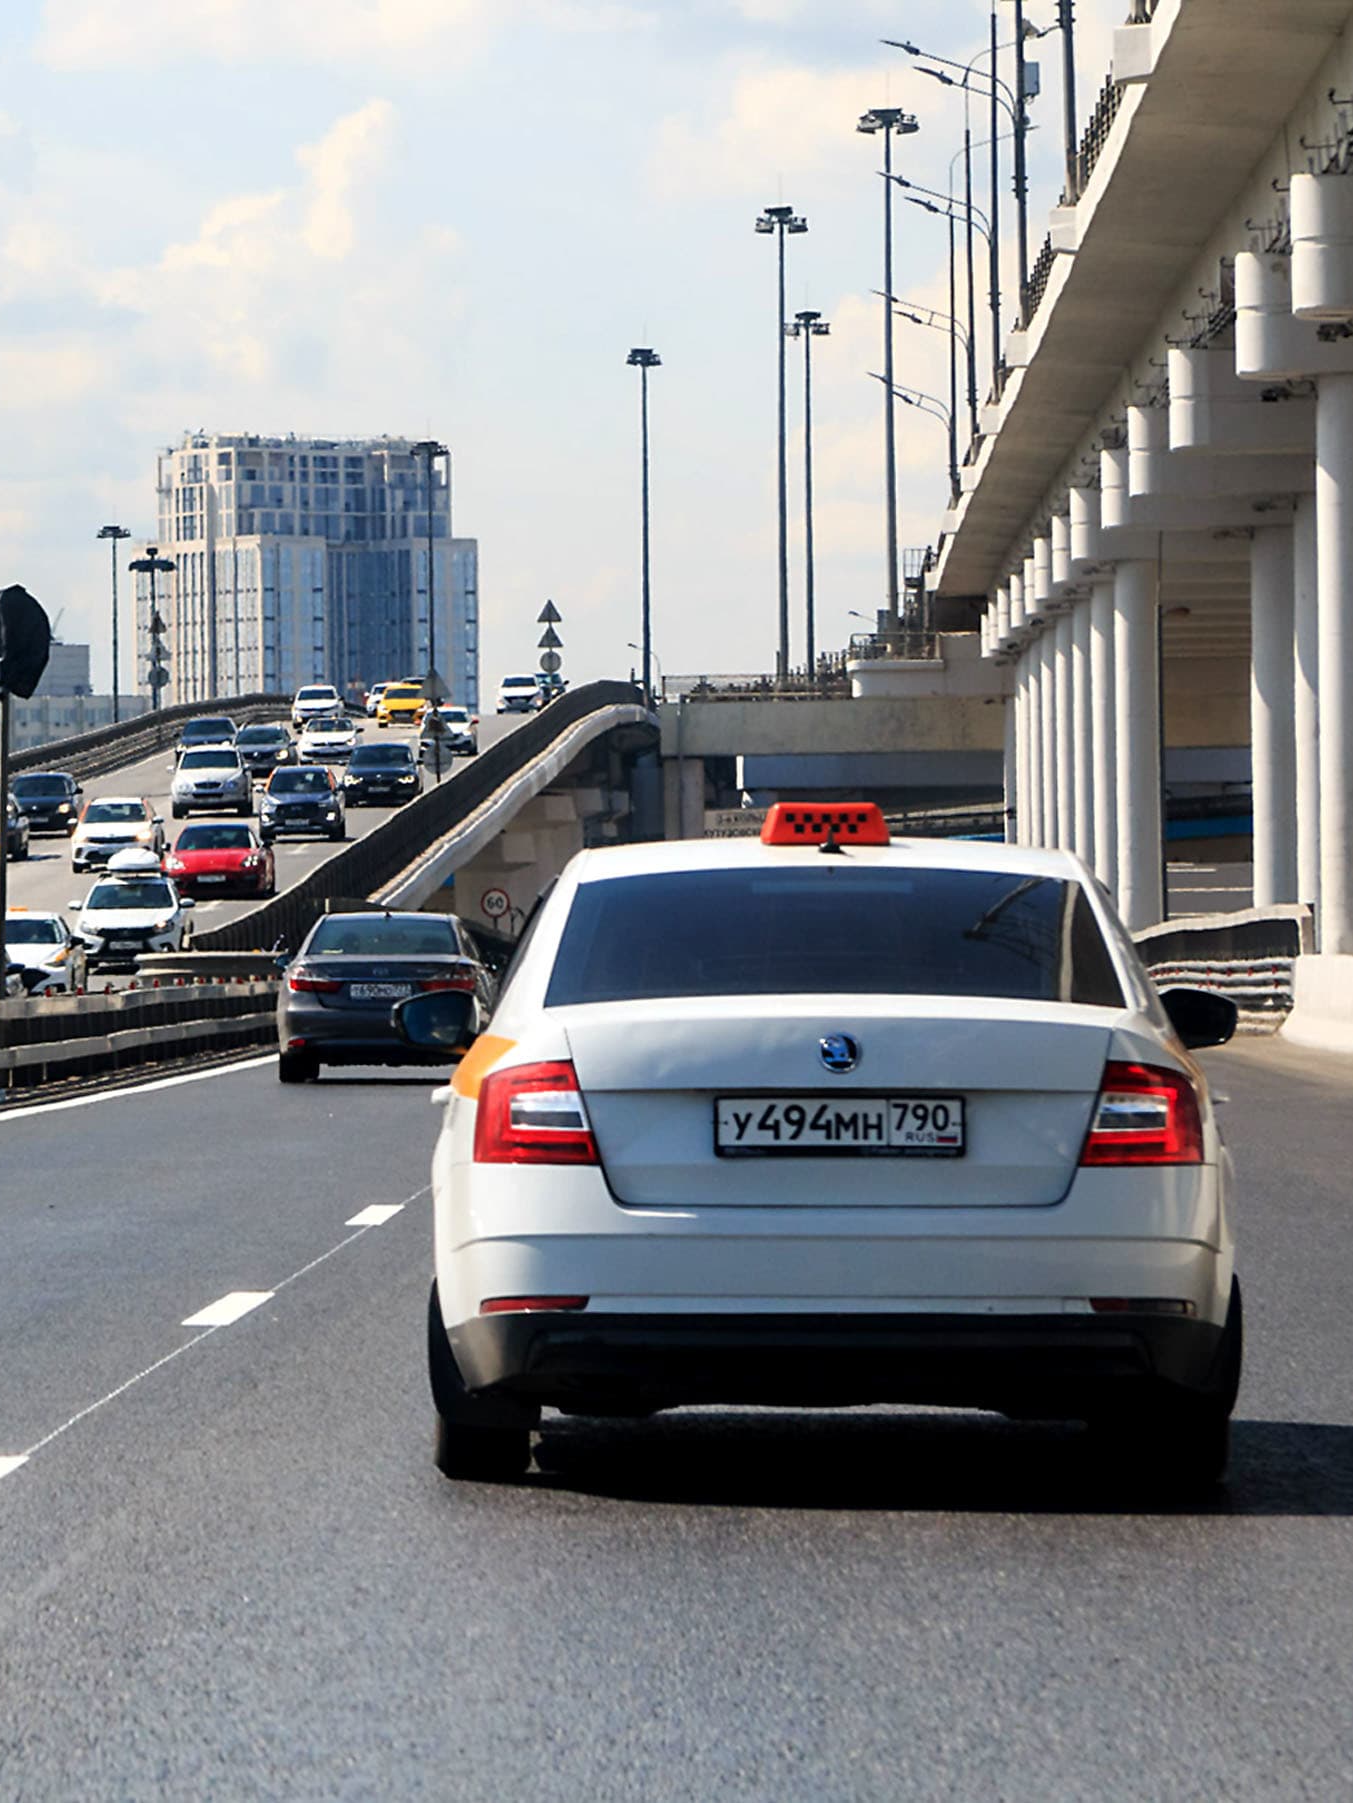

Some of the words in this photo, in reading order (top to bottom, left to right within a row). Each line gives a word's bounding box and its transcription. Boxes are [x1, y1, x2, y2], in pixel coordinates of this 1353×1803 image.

[486, 896, 504, 910] 60
[732, 1104, 883, 1140] У494МН
[892, 1103, 949, 1131] 790
[904, 1132, 935, 1142] RUS
